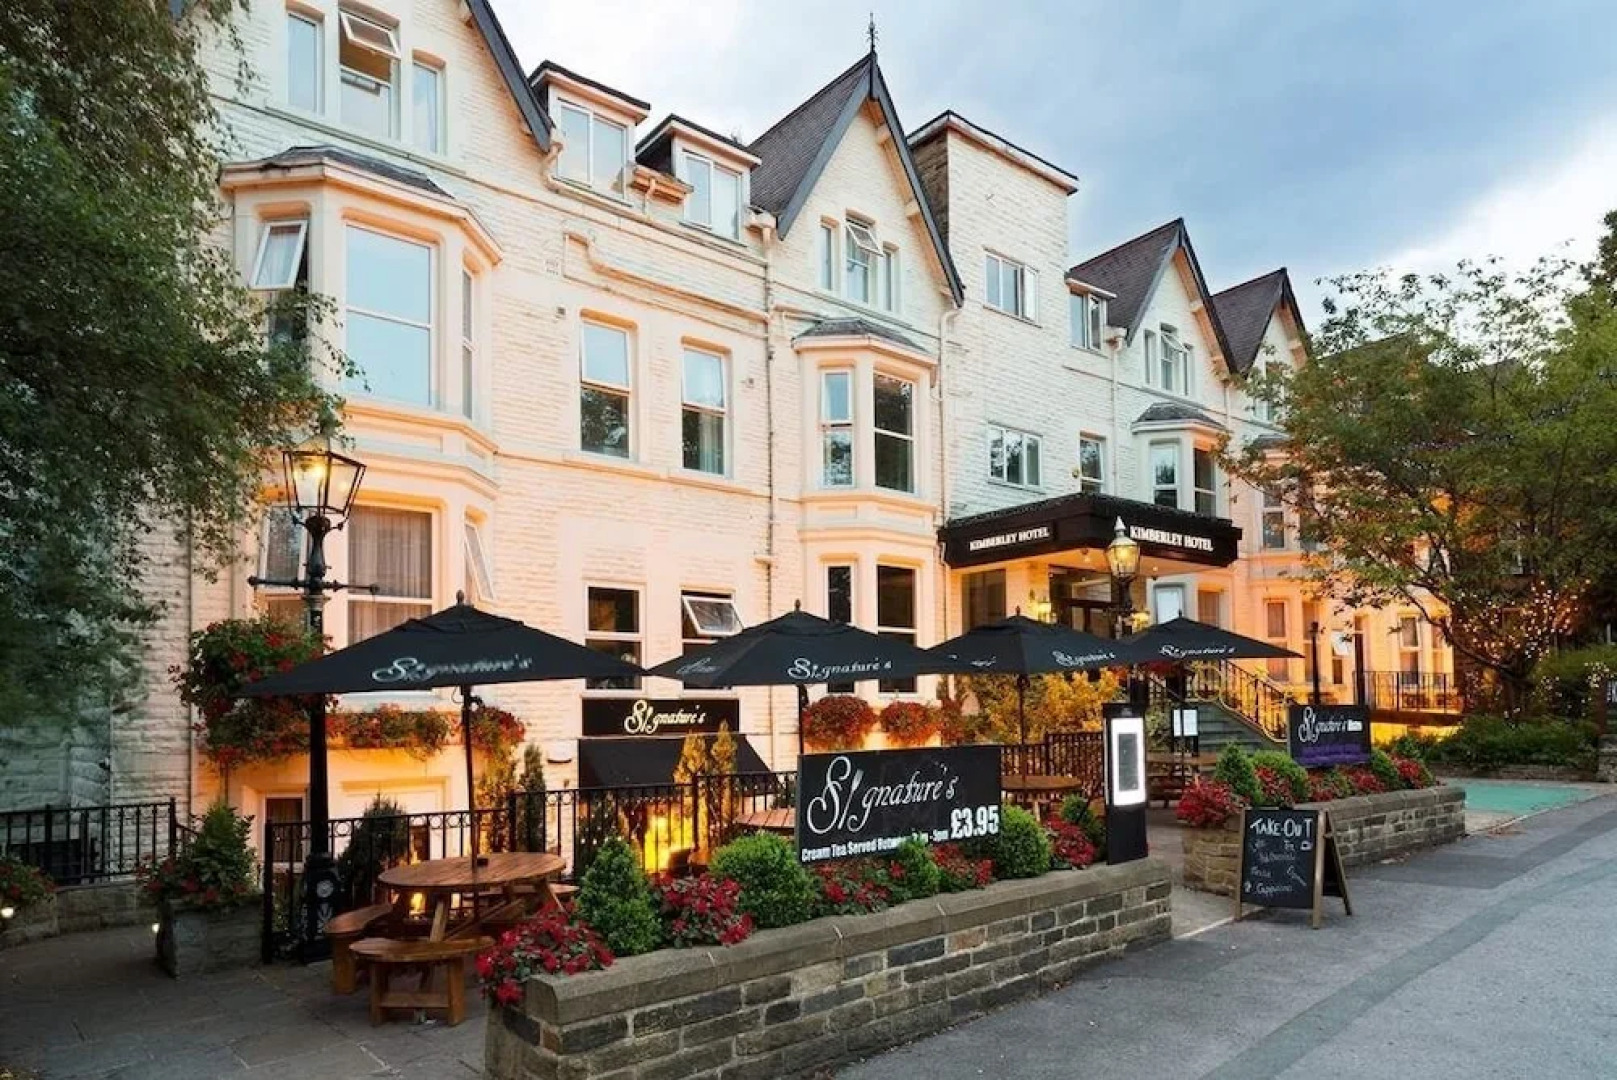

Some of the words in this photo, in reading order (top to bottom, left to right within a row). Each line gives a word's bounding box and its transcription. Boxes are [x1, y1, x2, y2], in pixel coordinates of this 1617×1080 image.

[970, 532, 1017, 551] KIMBERLEY
[1018, 526, 1050, 544] HOTEL
[1130, 525, 1183, 547] KIMBERLEY
[1184, 536, 1214, 552] HOTEL
[950, 804, 999, 839] £3.95
[831, 843, 847, 857] Tea
[847, 839, 877, 854] Served
